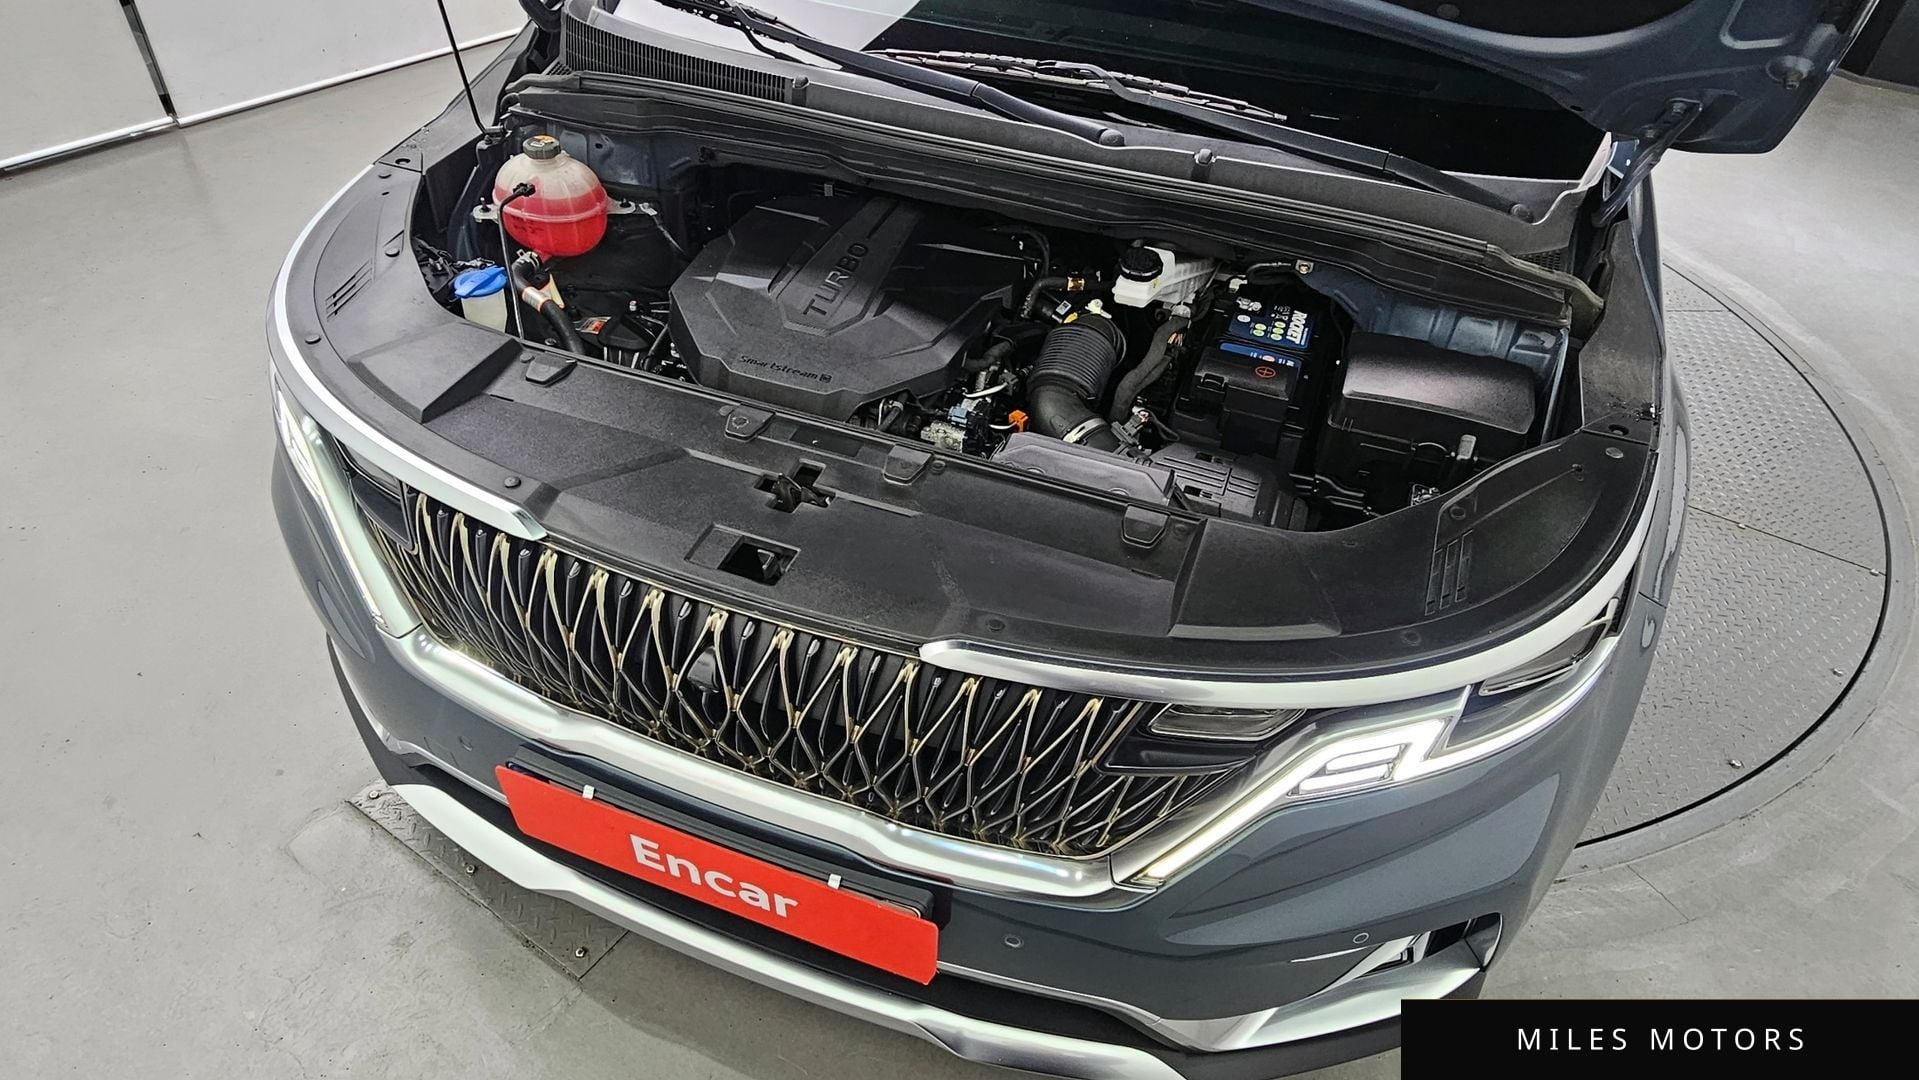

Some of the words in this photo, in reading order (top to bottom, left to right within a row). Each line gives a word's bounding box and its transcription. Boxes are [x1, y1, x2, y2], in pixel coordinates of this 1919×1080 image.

[803, 243, 869, 316] TURBO
[1286, 310, 1308, 345] ROCKET
[740, 355, 819, 380] Smartstream
[629, 834, 799, 918] Encar
